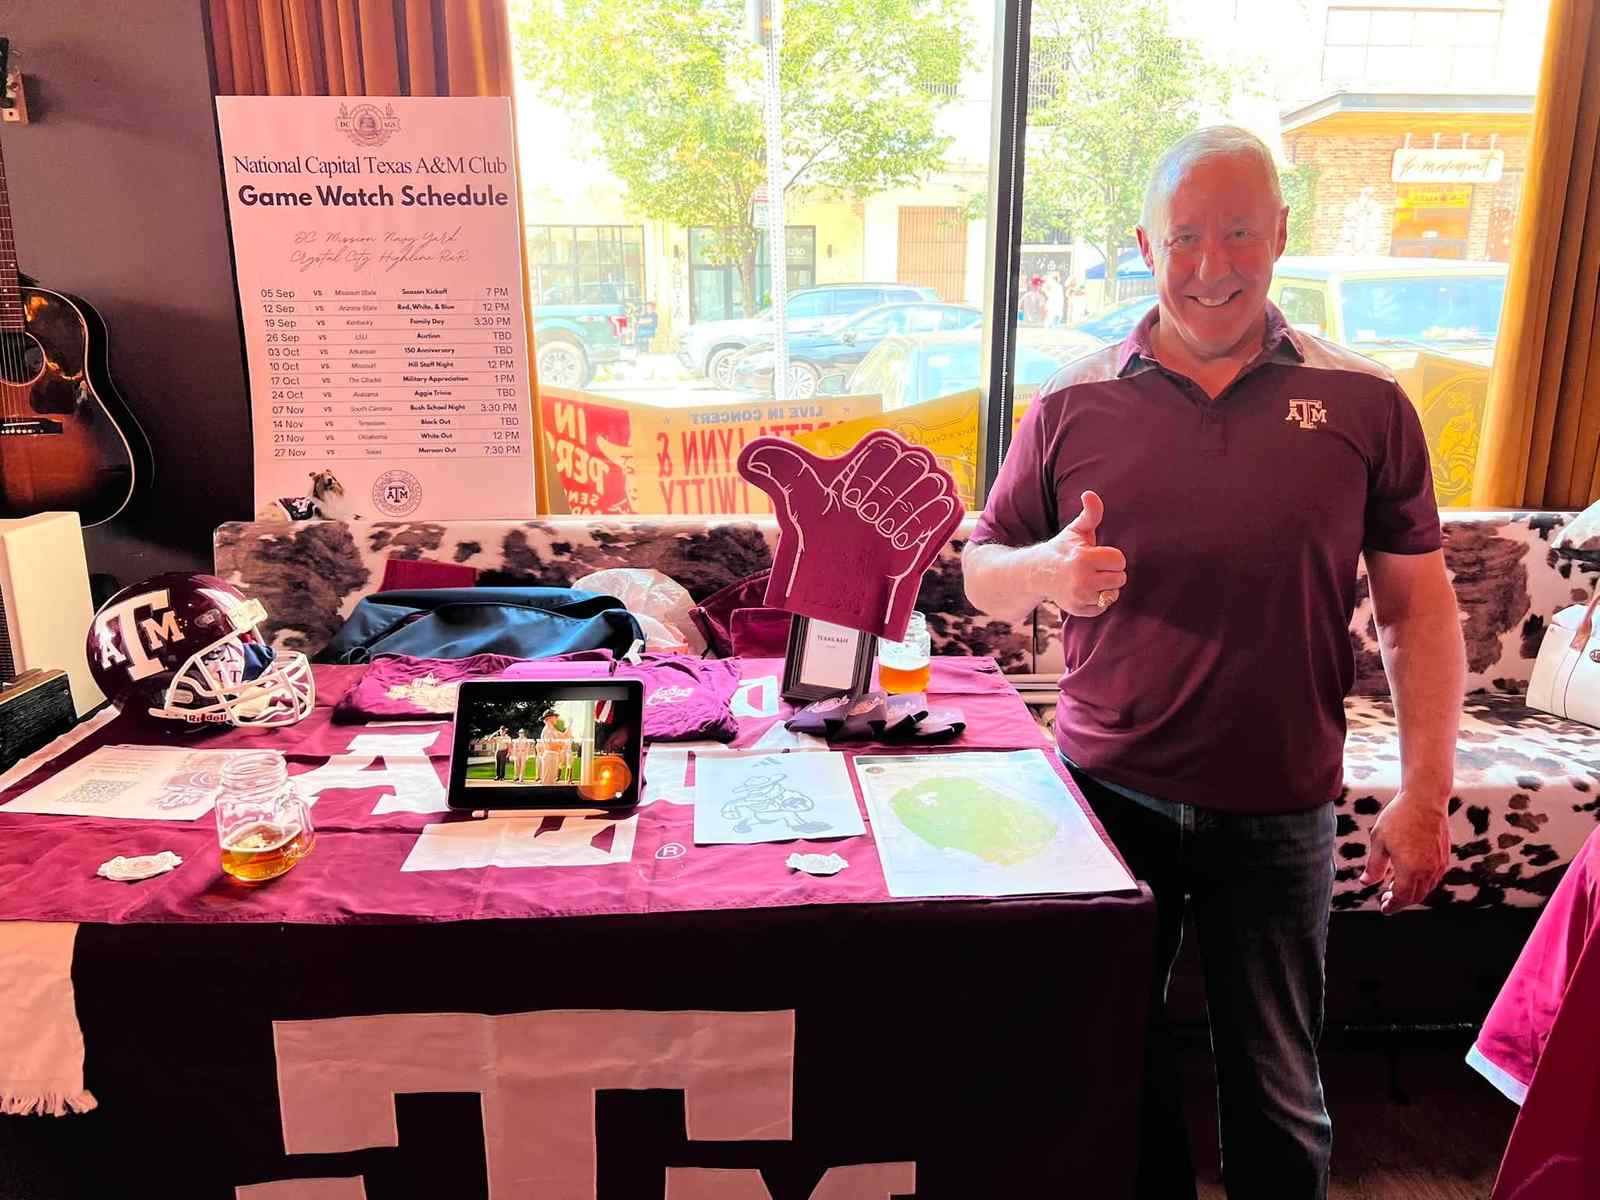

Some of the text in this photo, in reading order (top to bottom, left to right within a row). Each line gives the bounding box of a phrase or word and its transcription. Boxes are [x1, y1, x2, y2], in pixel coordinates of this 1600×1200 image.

[234, 155, 507, 178] National Capital Texas A&M Club
[239, 184, 508, 206] Game Watch Schedule
[261, 289, 273, 297] 05
[276, 289, 295, 299] Sep
[486, 288, 492, 296] 7
[494, 288, 508, 296] PM
[263, 304, 274, 312] 12
[275, 304, 294, 314] Sep
[495, 303, 509, 311] PM
[265, 319, 276, 327] 19
[277, 319, 296, 329] Sep
[410, 318, 432, 326] Family
[433, 318, 444, 326] Day
[496, 318, 510, 326] PM
[266, 334, 278, 342] 26
[281, 334, 300, 343] Sep
[494, 332, 511, 340] TBD
[268, 348, 280, 356] 03
[283, 348, 300, 356] Oct
[270, 363, 281, 371] 10
[283, 362, 300, 371] Oct
[271, 377, 282, 385] 17
[284, 377, 300, 385] Oct
[272, 391, 285, 399] 24
[287, 391, 303, 400] Oct
[272, 406, 284, 414] 07
[286, 406, 304, 414] Nov
[447, 404, 465, 412] Night
[502, 403, 517, 412] PM
[273, 420, 284, 428] 14
[286, 420, 303, 428] Nov
[501, 417, 518, 425] TBD
[274, 434, 285, 442] 21
[287, 434, 304, 442] Nov
[493, 432, 503, 440] 12
[505, 432, 519, 440] PM
[275, 448, 287, 456] 27
[289, 448, 306, 456] Nov
[506, 446, 520, 454] PM
